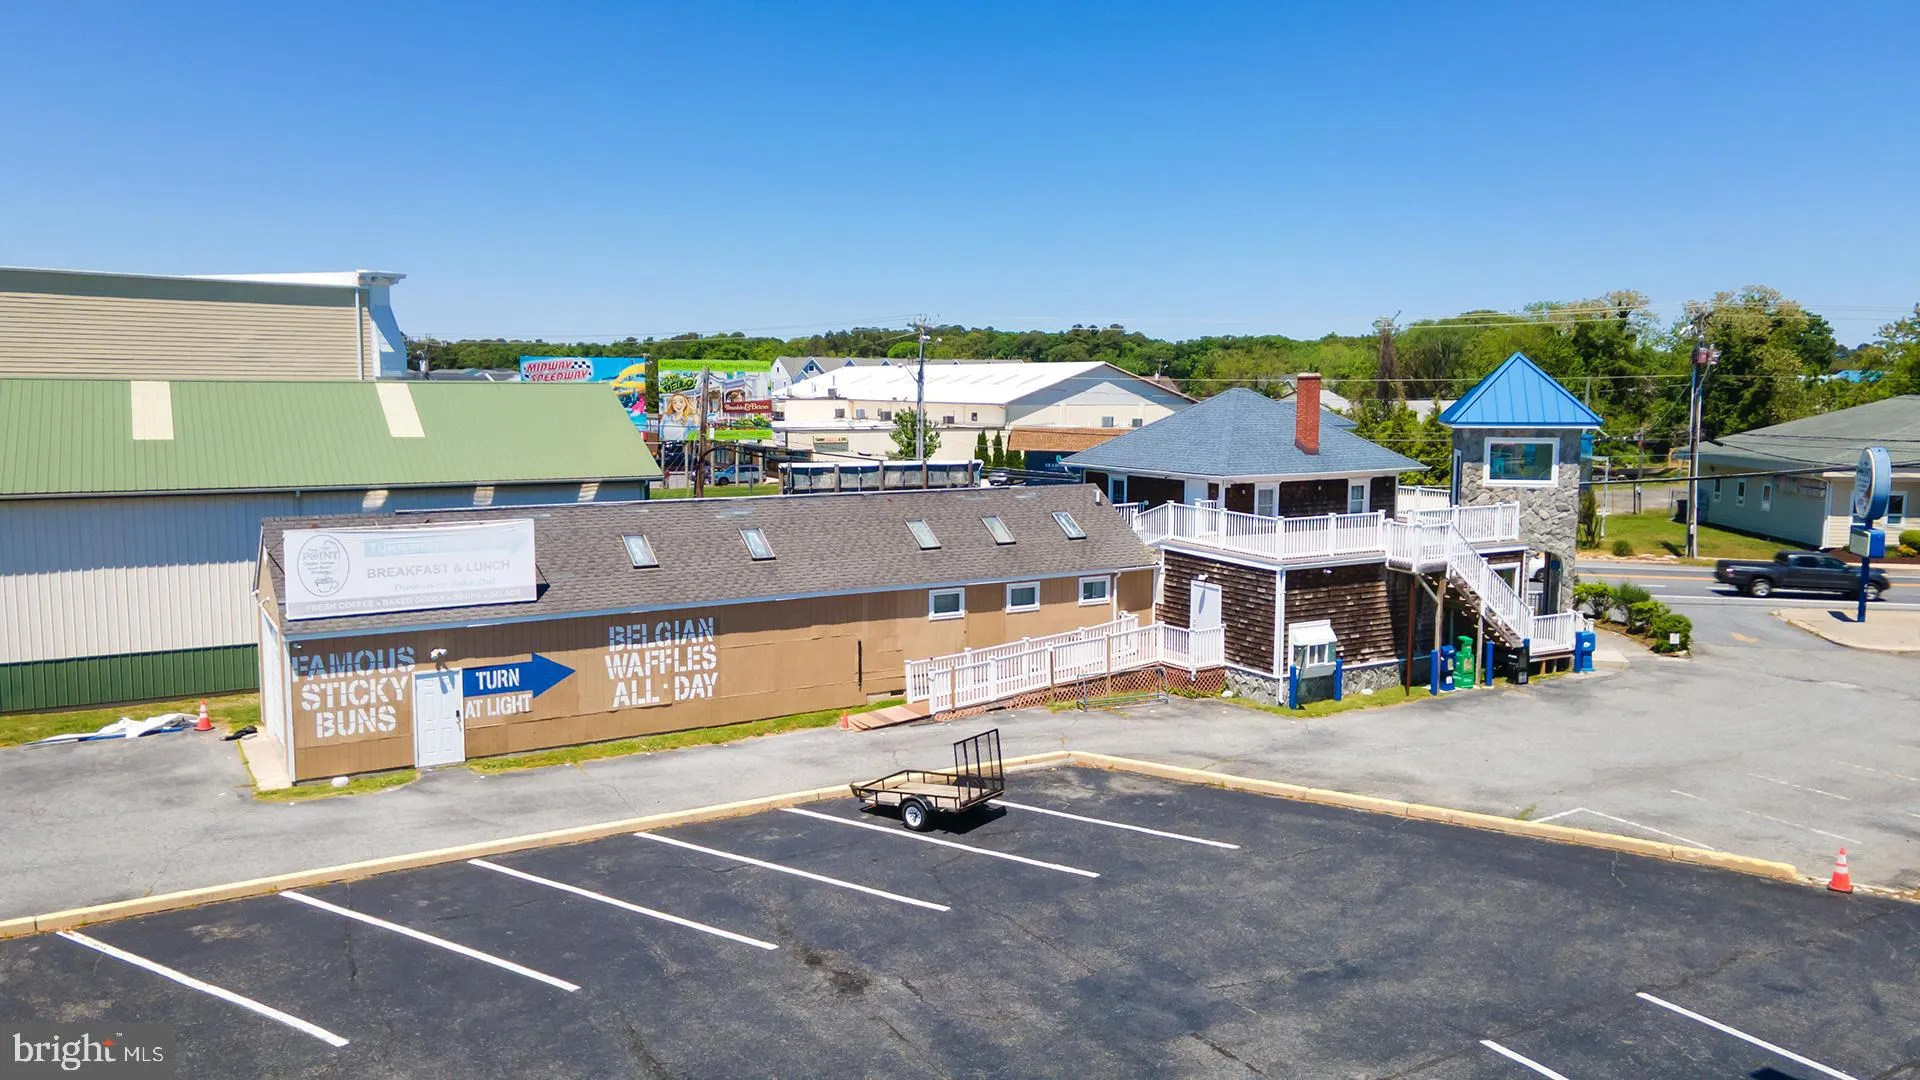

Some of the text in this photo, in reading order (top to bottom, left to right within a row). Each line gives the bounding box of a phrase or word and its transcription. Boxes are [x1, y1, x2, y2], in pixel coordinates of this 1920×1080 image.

[527, 360, 572, 372] MIDWAY
[531, 370, 588, 382] SPEEDWAY
[367, 560, 510, 578] BREAKFAST & LUNCH
[305, 601, 337, 612] FRESH
[339, 598, 375, 610] COFFEE
[609, 616, 714, 652] BELGIAN
[291, 646, 416, 682] FAMOUS
[604, 644, 718, 680] WAFFLES
[301, 675, 409, 711] STICKY
[475, 667, 520, 690] TURN
[613, 672, 718, 708] ALL DAY
[464, 693, 532, 719] AT LIGHT
[316, 705, 397, 738] BUNS
